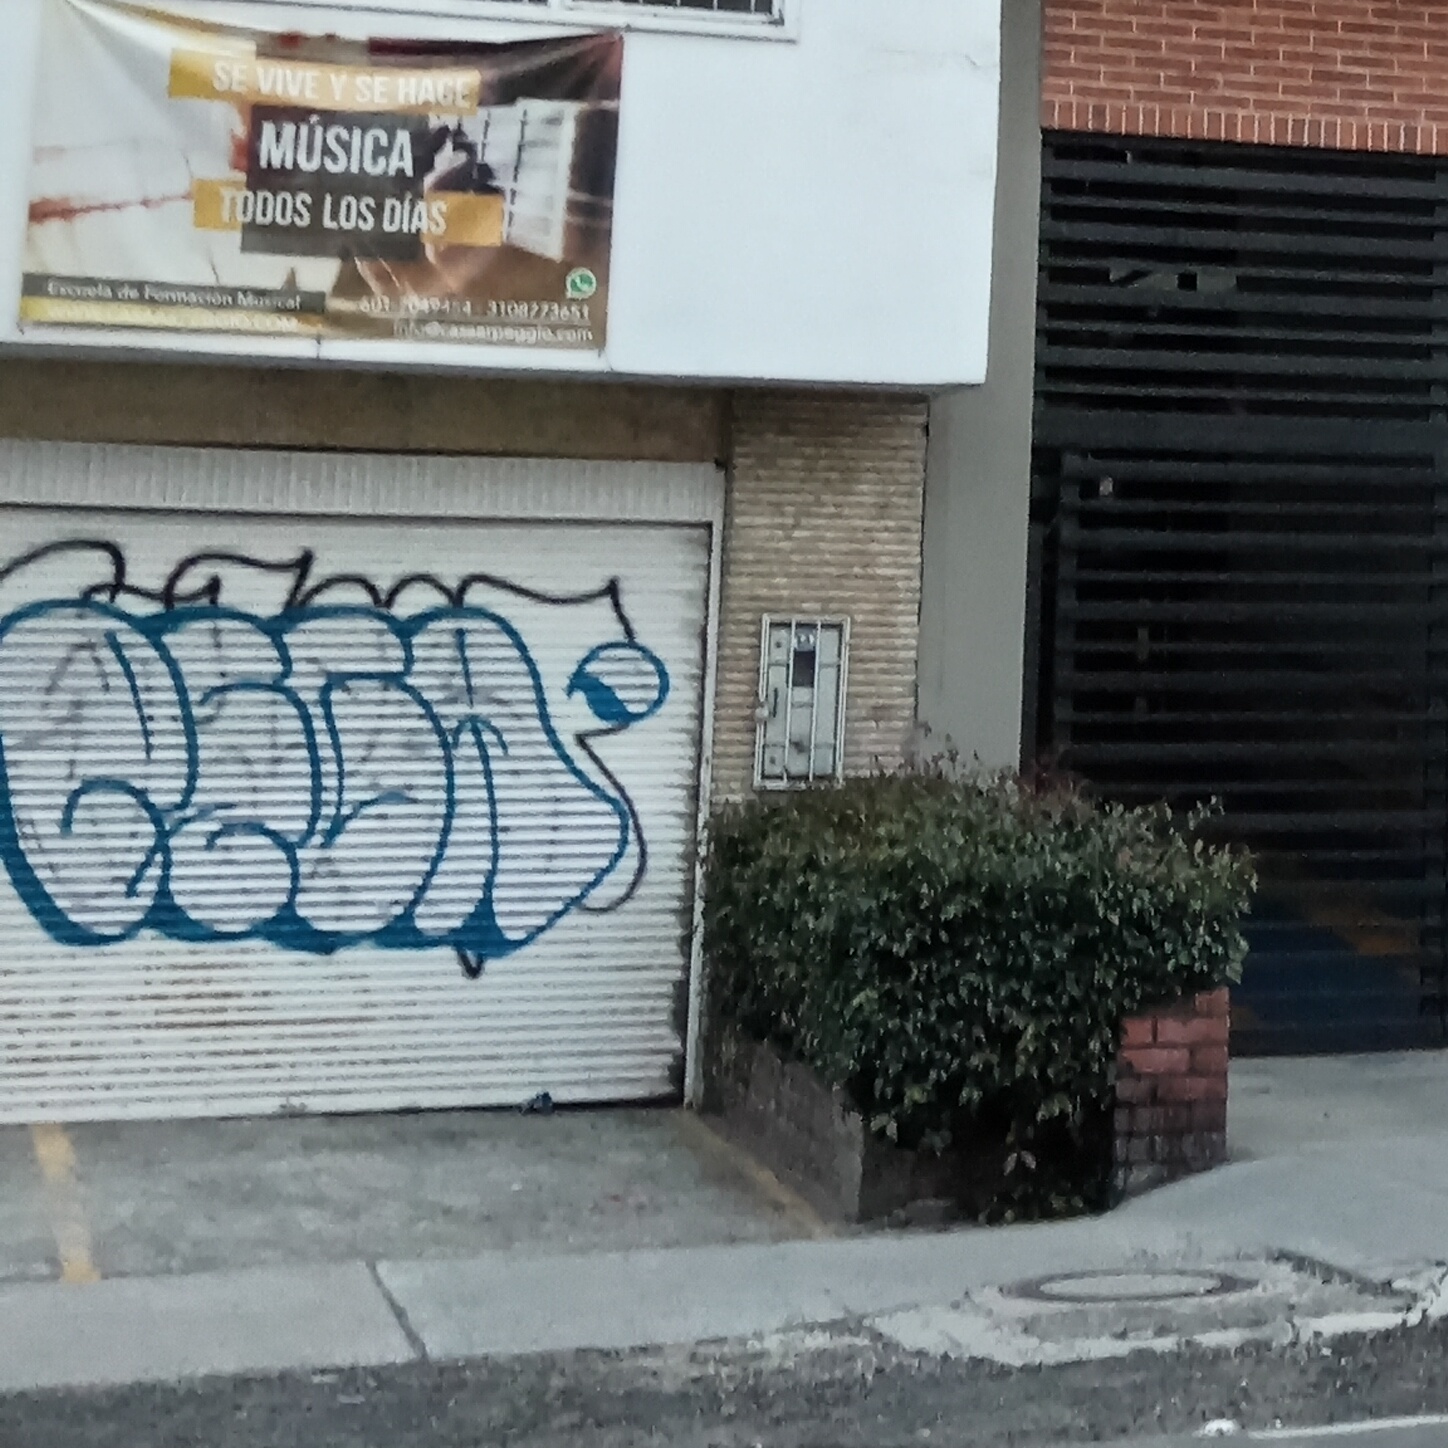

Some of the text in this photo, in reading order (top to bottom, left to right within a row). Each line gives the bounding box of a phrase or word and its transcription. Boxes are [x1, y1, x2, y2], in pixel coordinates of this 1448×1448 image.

[212, 60, 247, 93] SE
[256, 65, 321, 99] VIVE
[330, 72, 348, 101] Y
[355, 72, 390, 104] SE
[259, 113, 414, 178] MÚSICA
[219, 187, 447, 235] TODOS LOS DÍAS
[117, 282, 140, 299] de
